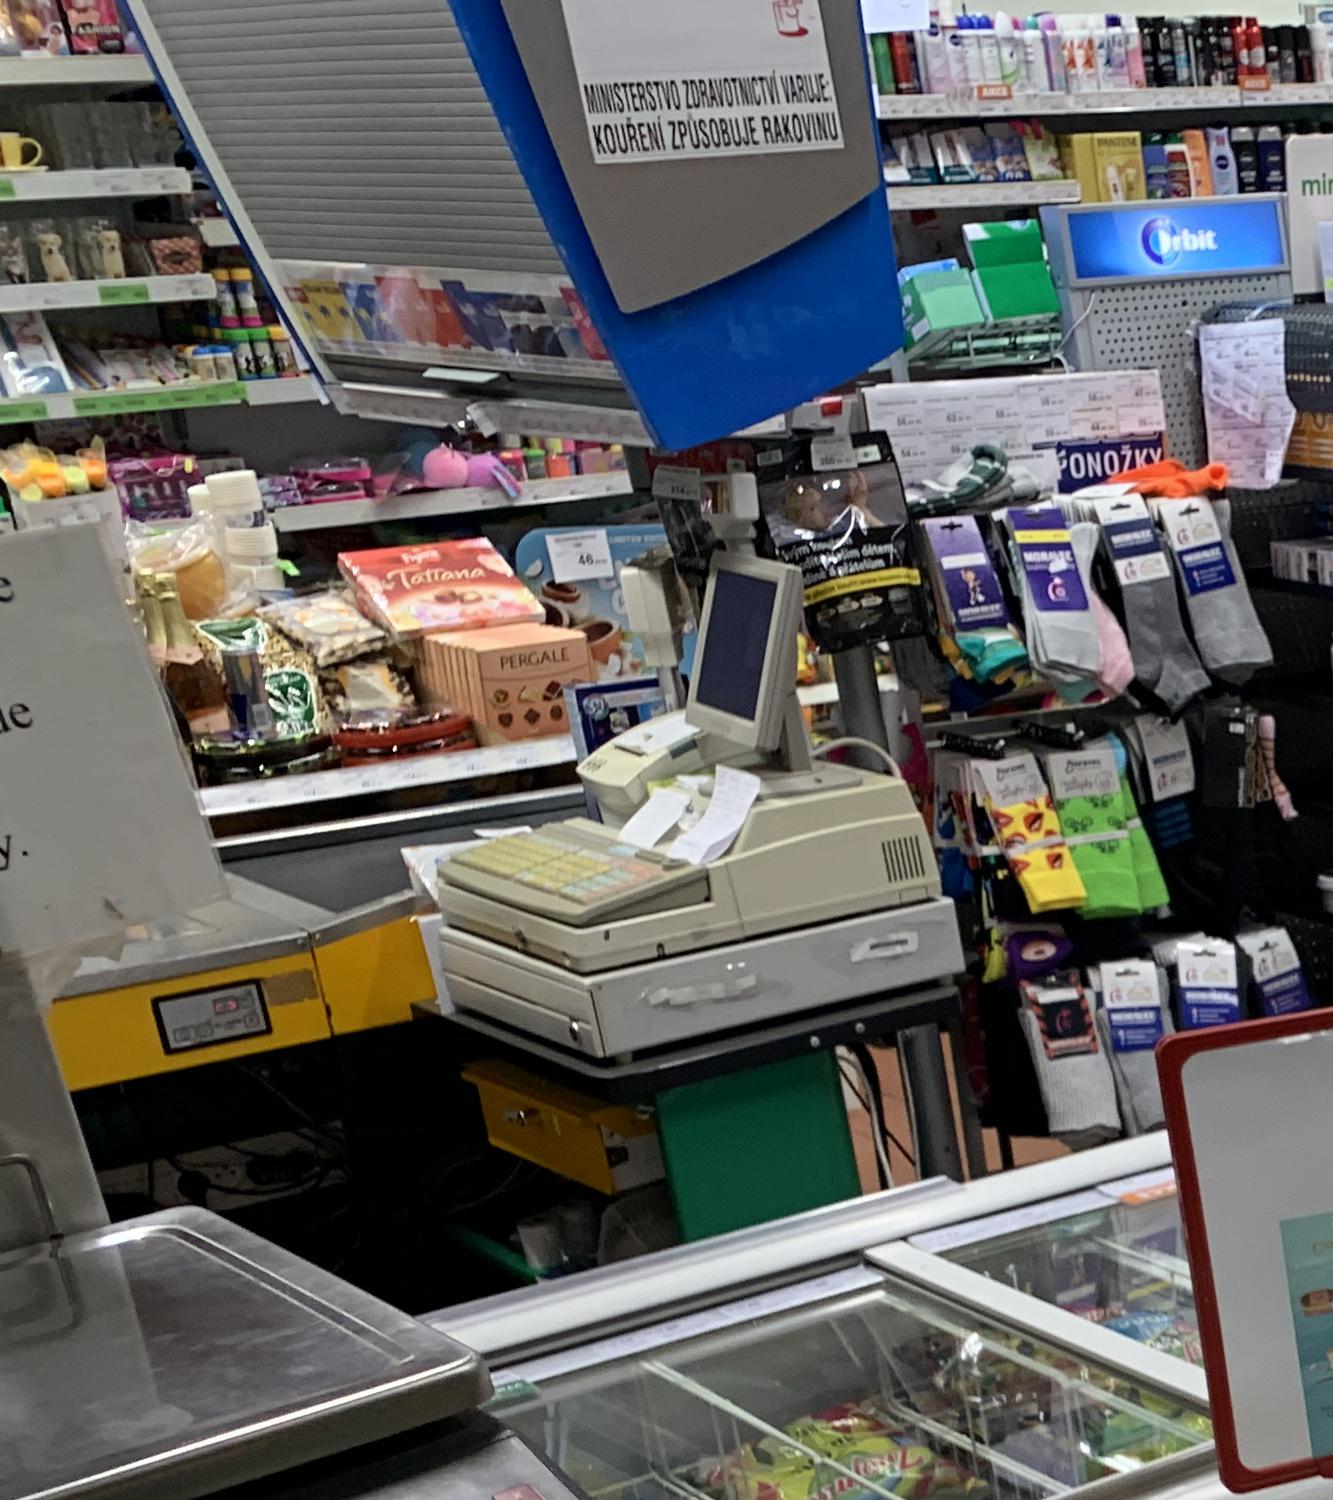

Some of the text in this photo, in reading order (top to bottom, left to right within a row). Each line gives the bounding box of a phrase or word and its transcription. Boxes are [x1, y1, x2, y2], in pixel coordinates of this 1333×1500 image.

[583, 69, 832, 114] MINISTERSTVO ZDRAVOTNICTVÍ VARUJE:
[592, 112, 839, 154] KOUŘENÍ ZPŮSOBUJE RAKOVINU
[1140, 217, 1218, 268] Orbit
[500, 648, 571, 671] PERGALE
